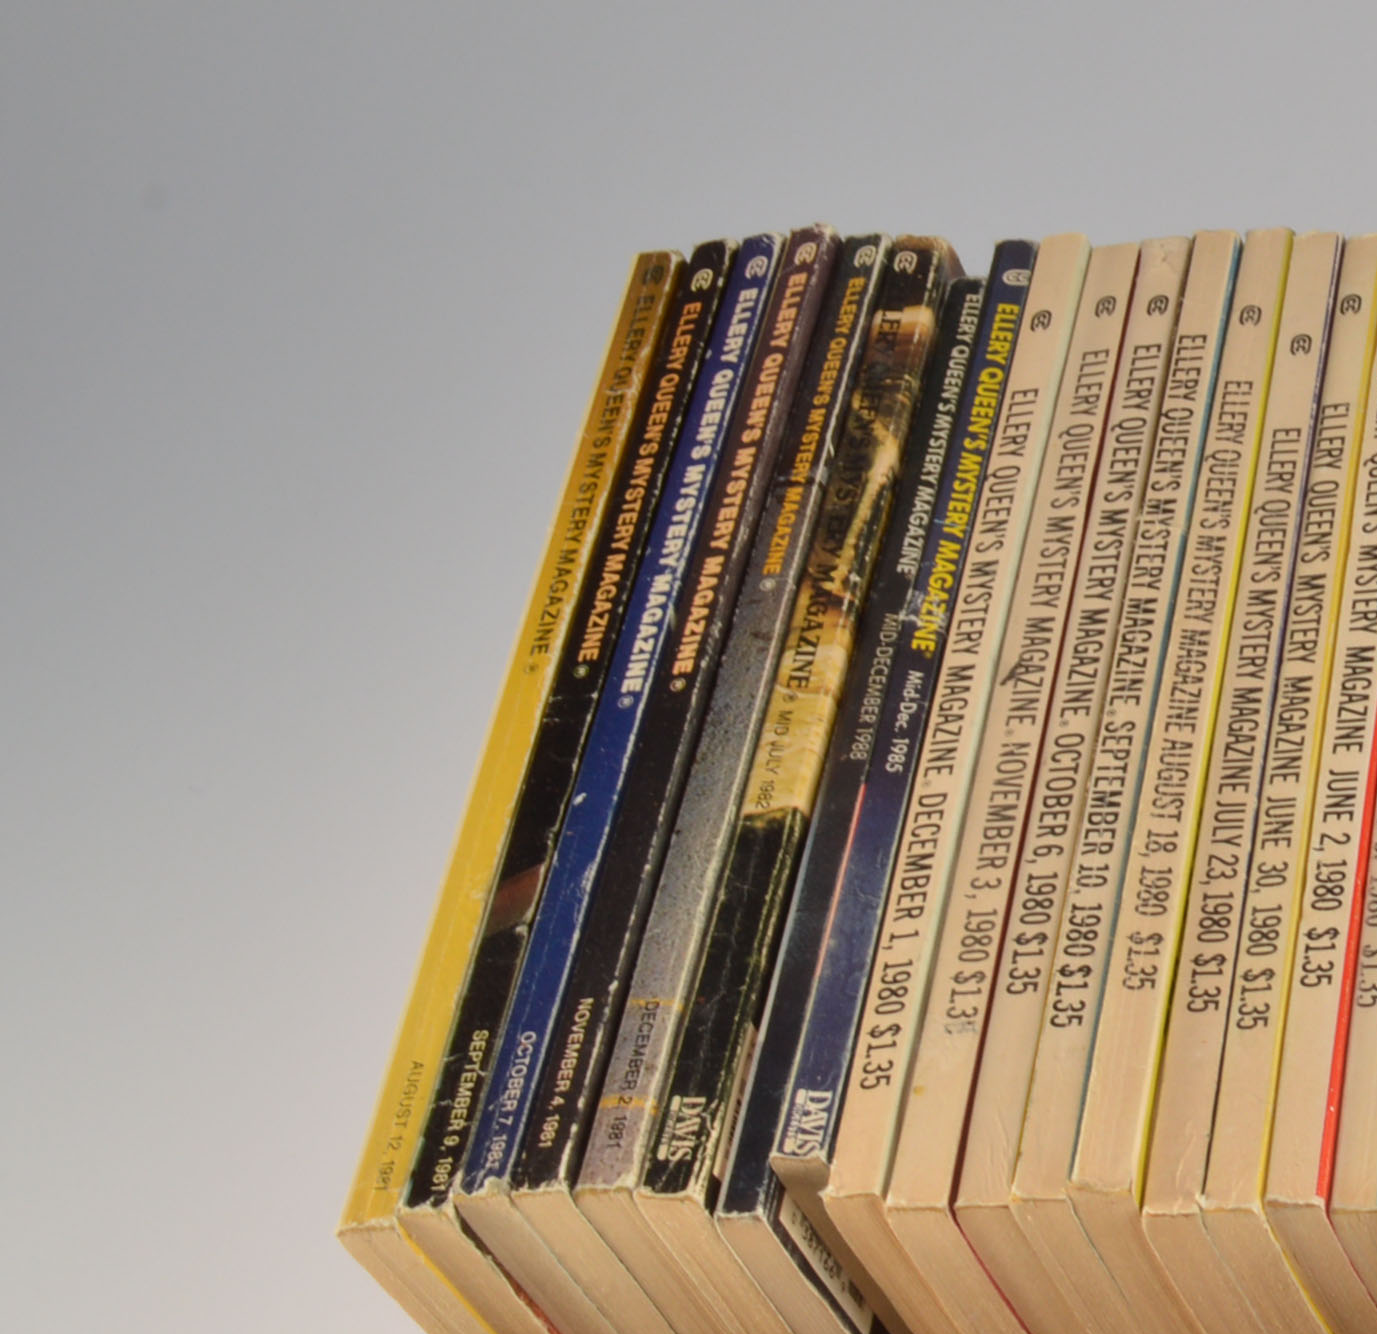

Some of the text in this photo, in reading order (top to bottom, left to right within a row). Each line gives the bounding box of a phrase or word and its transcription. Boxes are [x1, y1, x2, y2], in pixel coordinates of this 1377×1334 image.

[666, 302, 702, 370] ELLERY
[1000, 388, 1039, 457] ELLERY
[611, 458, 654, 550] MYSTERY
[911, 303, 1021, 653] ELLERY QUEEN'S MYSTERY MAGAZINE
[975, 466, 1021, 553] QUEEN'S
[578, 554, 626, 662] MAGAZINE
[950, 560, 999, 657] MYSTERY
[885, 738, 910, 773] 1985
[923, 664, 976, 778] MAGAZINE
[893, 792, 948, 924] DECEMBER
[874, 959, 913, 1016] 1980
[448, 1029, 490, 1131] SEPTEMBER
[859, 1023, 901, 1091] $1.35
[430, 1157, 453, 1191] 1981
